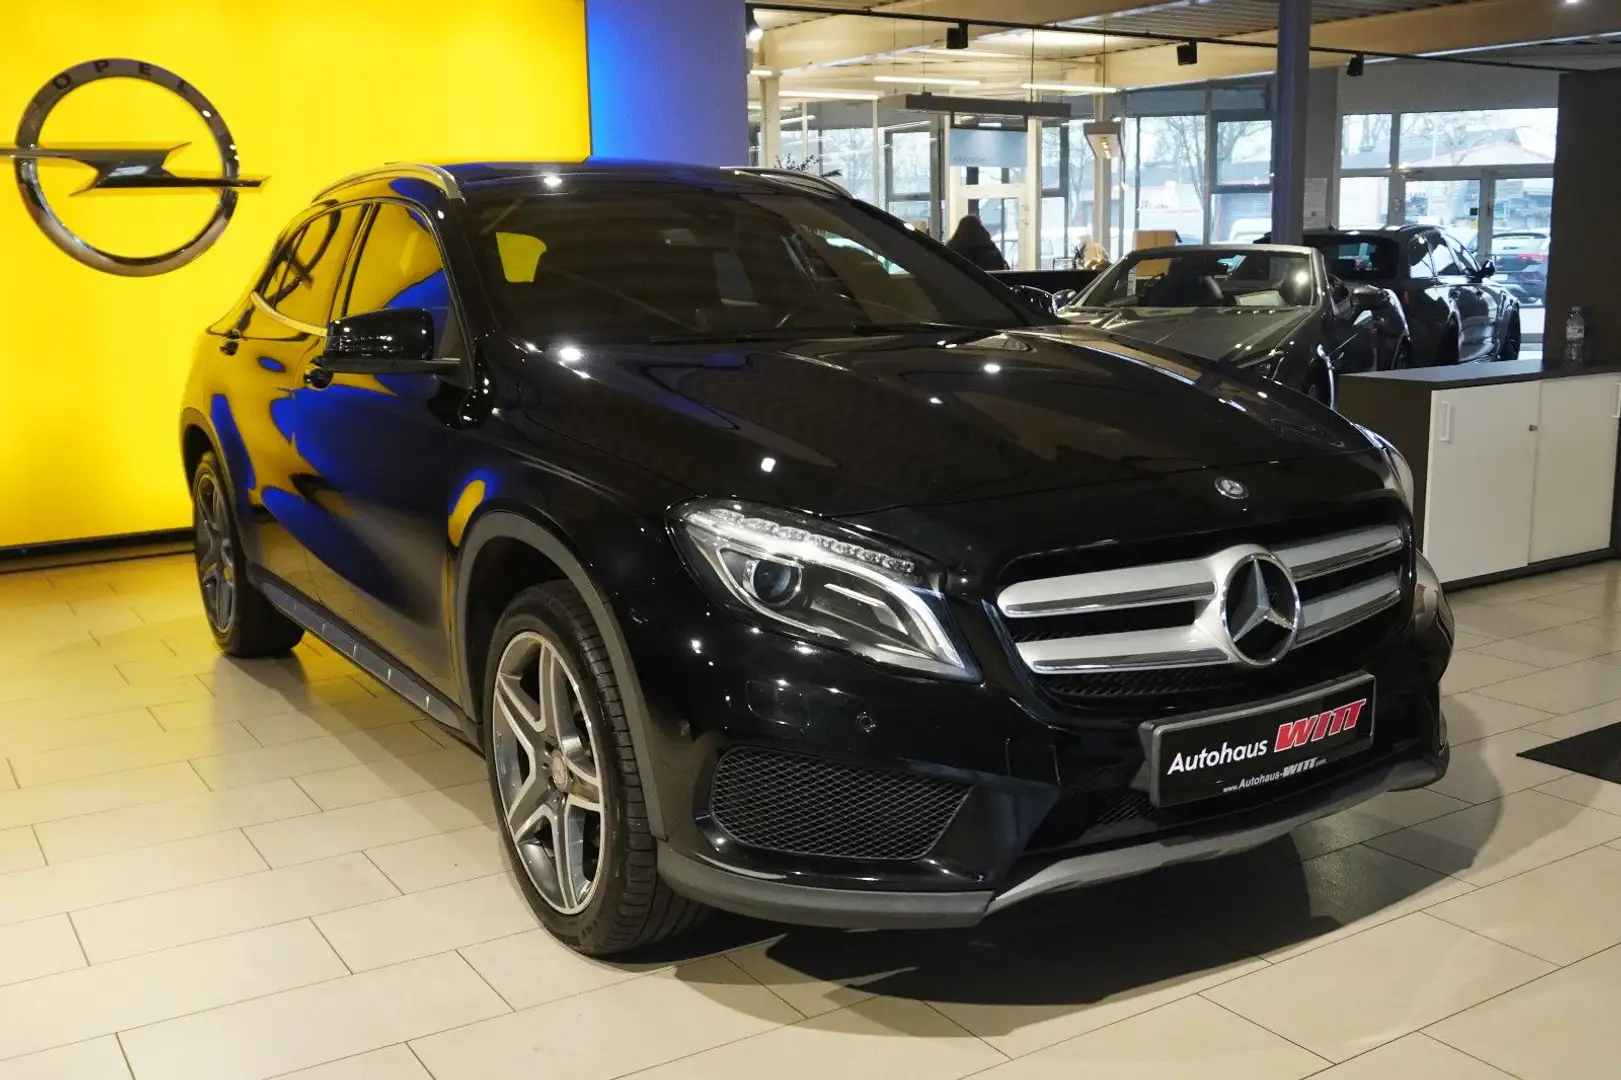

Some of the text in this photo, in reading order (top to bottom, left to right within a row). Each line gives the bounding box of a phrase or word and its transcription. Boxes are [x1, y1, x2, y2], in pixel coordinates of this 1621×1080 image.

[53, 59, 189, 94] OPEL
[1167, 698, 1367, 775] Autohaus WITT
